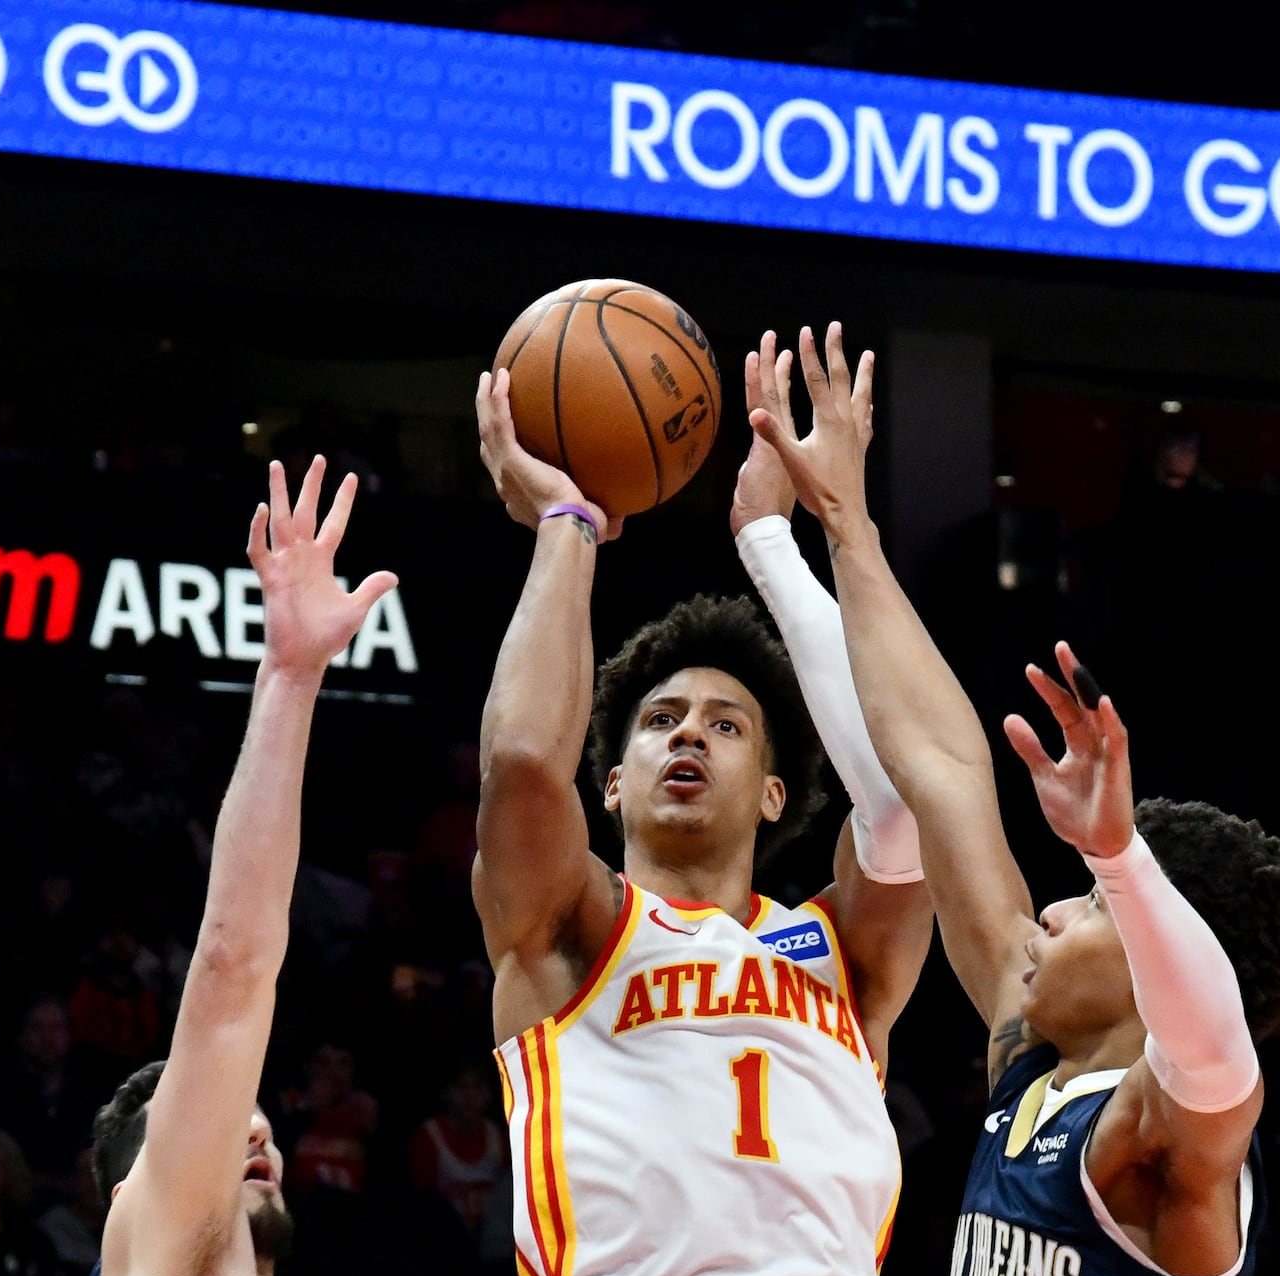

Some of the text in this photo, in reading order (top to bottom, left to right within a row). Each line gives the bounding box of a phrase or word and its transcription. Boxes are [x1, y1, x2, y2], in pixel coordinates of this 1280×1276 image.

[43, 23, 200, 133] GO
[609, 82, 1000, 214] ROOMS
[1023, 123, 1154, 227] TO
[89, 557, 419, 673] AREA
[611, 954, 862, 1063] ATLANTA
[728, 1047, 780, 1164] 1
